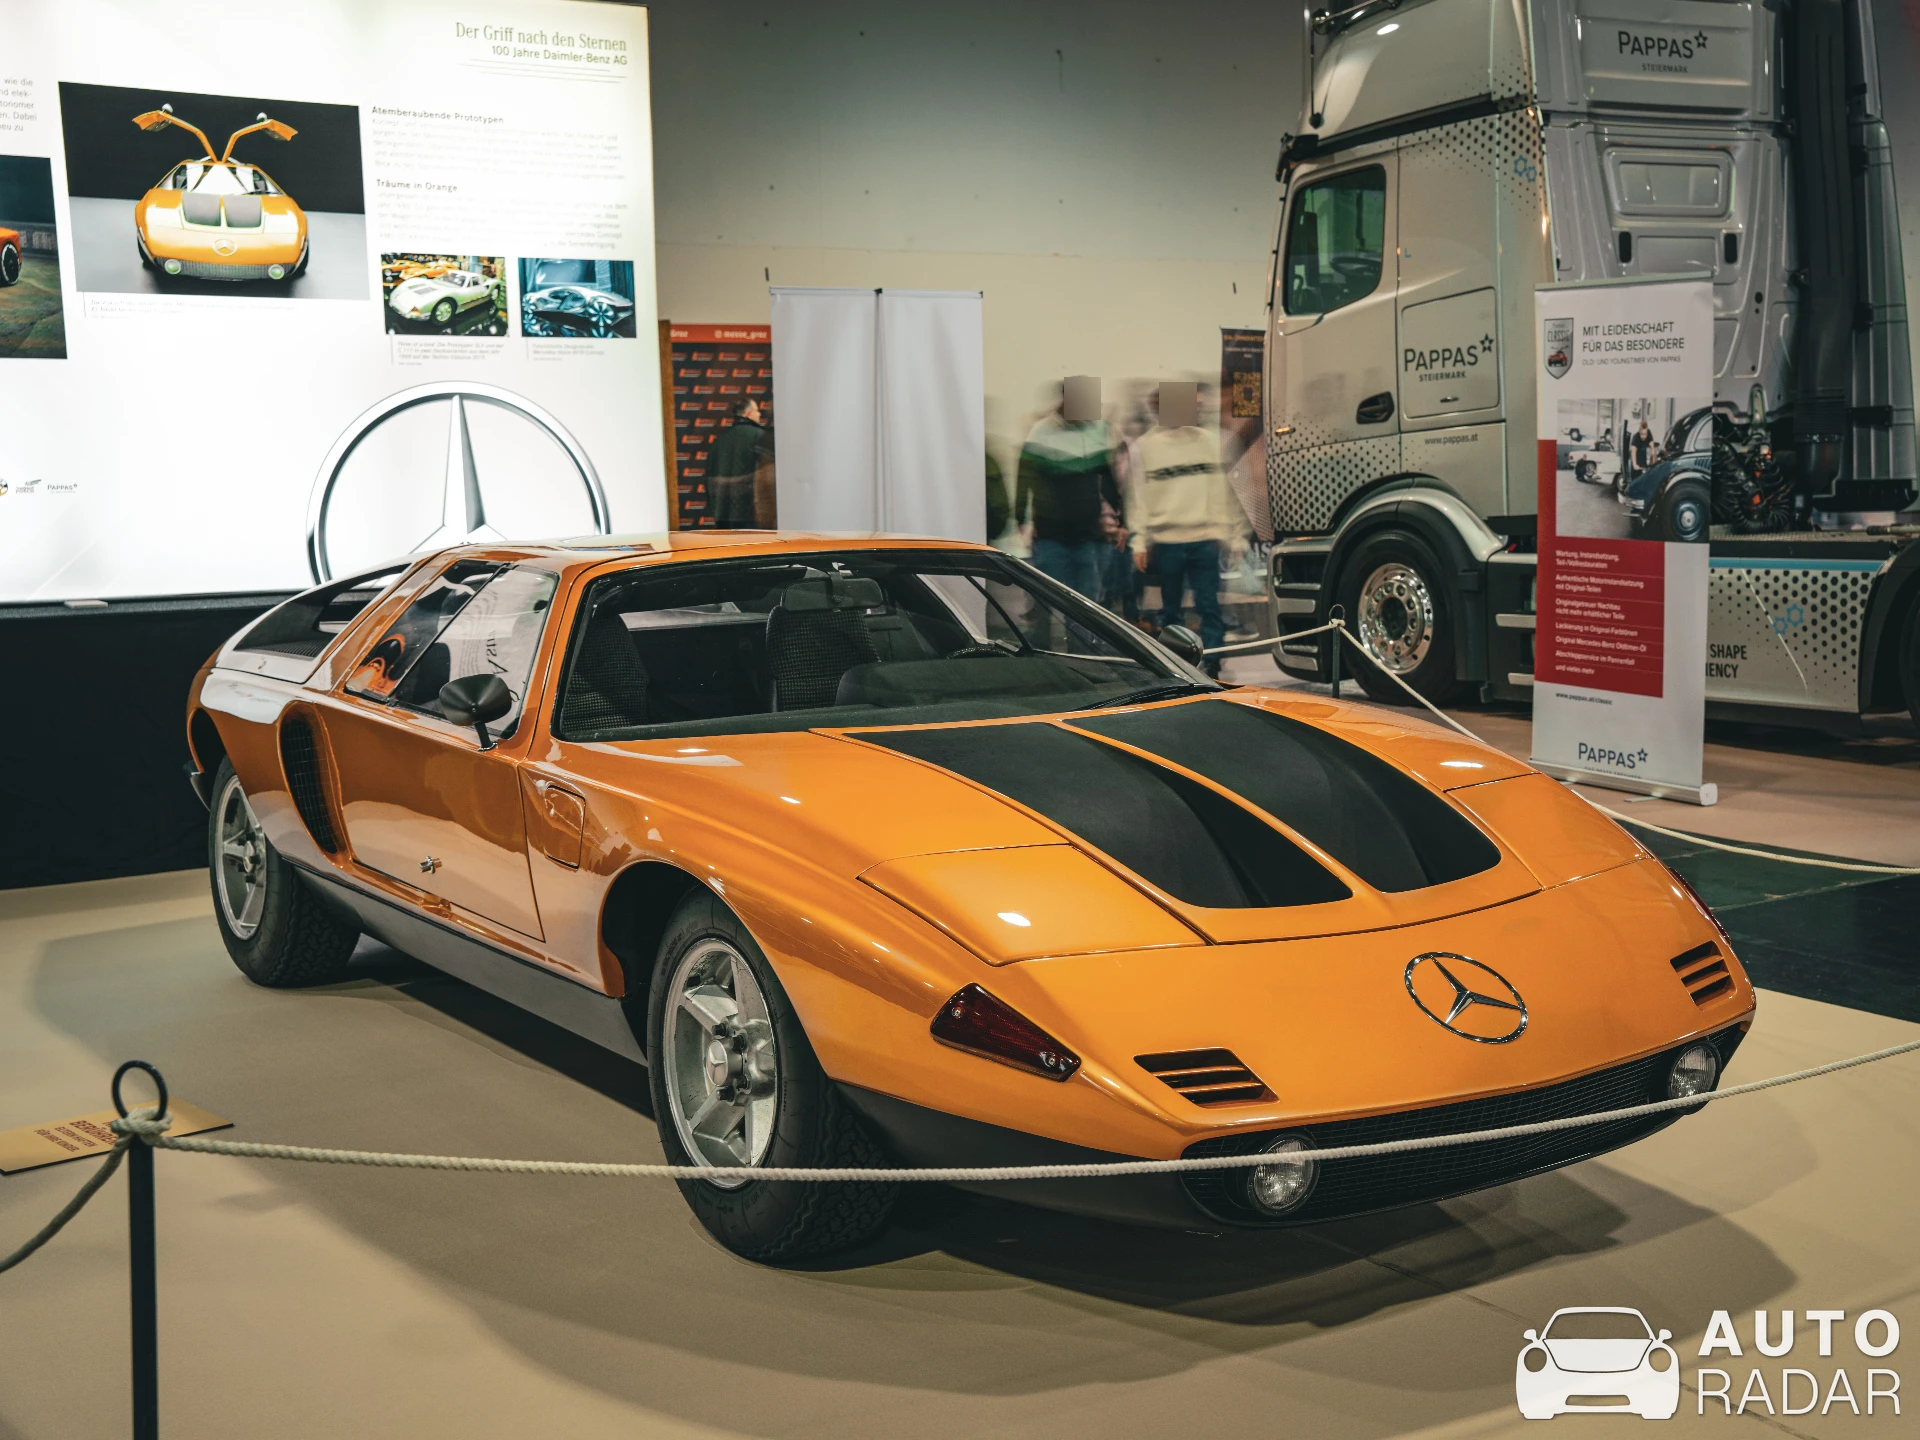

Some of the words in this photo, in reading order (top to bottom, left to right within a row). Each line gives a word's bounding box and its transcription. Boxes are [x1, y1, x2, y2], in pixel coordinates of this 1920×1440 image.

[456, 22, 479, 39] Der
[483, 25, 514, 42] Griff
[518, 30, 548, 45] nach
[552, 32, 575, 48] den
[579, 33, 627, 51] Sternen
[1618, 30, 1693, 59] PAPPAS
[492, 45, 509, 56] 100
[513, 47, 540, 58] Jahre
[544, 49, 610, 65] Daimler-Benz
[613, 55, 627, 65] AG
[1641, 63, 1688, 73] STEIERMARK
[21, 78, 33, 86] die
[372, 106, 451, 120] Atemberaubende
[454, 112, 504, 124] Prototypen
[376, 179, 411, 189] Träume
[414, 181, 422, 189] in
[425, 182, 458, 193] Orange
[1583, 325, 1599, 336] MIT
[1602, 322, 1674, 336] LEIDENSCHAFT
[1583, 340, 1602, 352] FÜR
[1604, 341, 1623, 352] DAS
[1626, 338, 1685, 351] BESONDERE
[1404, 345, 1478, 372] PAPPAS
[1419, 371, 1466, 382] STEIERMARK
[1424, 434, 1478, 445] www.pappas.at
[1709, 643, 1747, 660] SHAPE
[1578, 742, 1636, 769] PAPPAS
